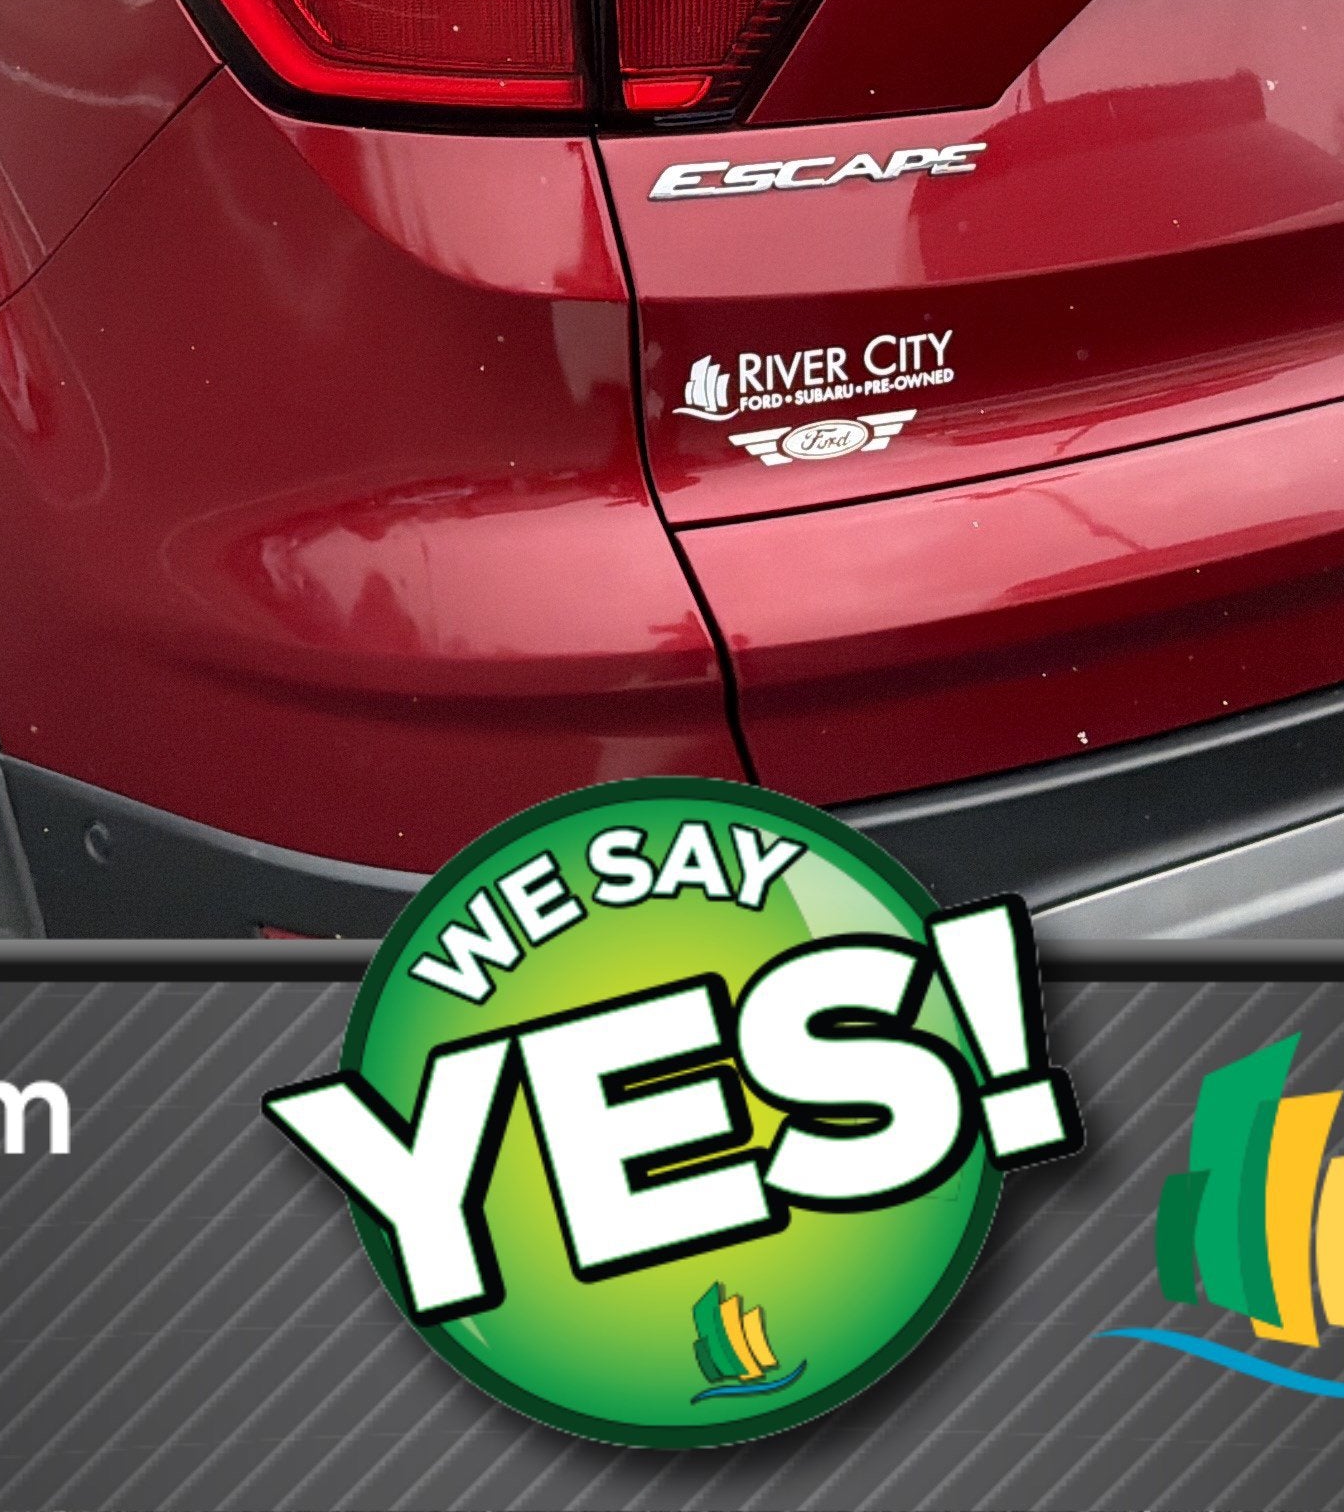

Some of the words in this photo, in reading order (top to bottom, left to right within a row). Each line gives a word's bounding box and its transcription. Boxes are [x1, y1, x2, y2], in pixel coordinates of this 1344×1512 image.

[648, 142, 987, 201] ESCAPE
[739, 347, 849, 394] RIVER
[863, 329, 953, 376] CITY
[739, 392, 783, 412] FORD
[794, 383, 854, 405] SUBARU
[864, 368, 954, 395] PRE-OWNED
[800, 427, 851, 451] Ford
